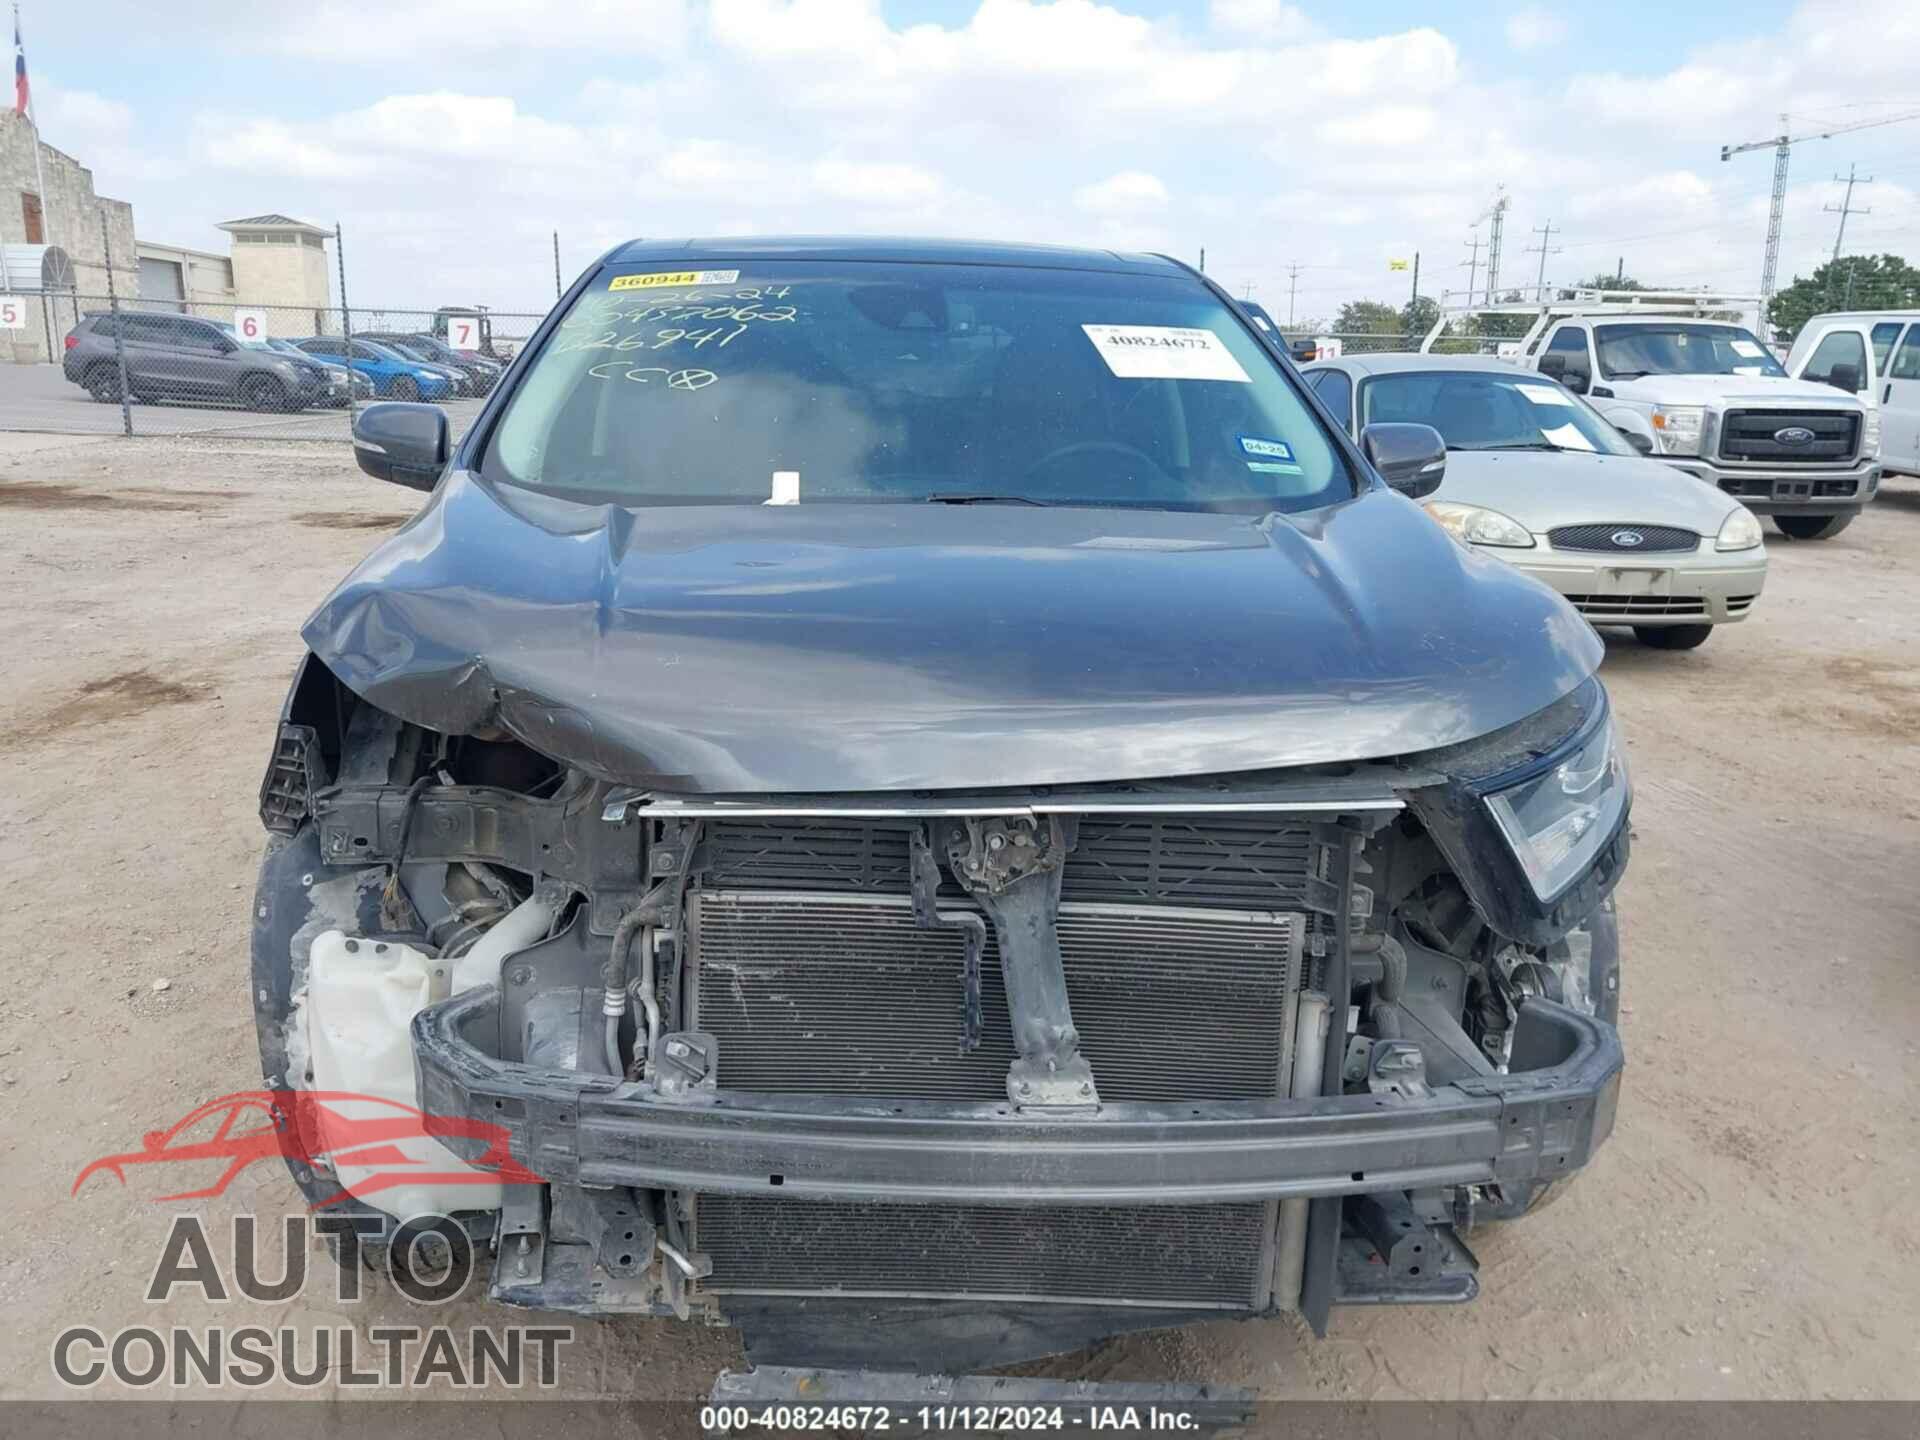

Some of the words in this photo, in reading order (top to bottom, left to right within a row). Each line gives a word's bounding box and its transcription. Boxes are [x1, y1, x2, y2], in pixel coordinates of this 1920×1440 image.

[613, 272, 697, 289] 360944
[2, 303, 17, 323] 5
[242, 316, 257, 337] 6
[455, 324, 471, 344] 7
[1106, 335, 1212, 350] 40824672
